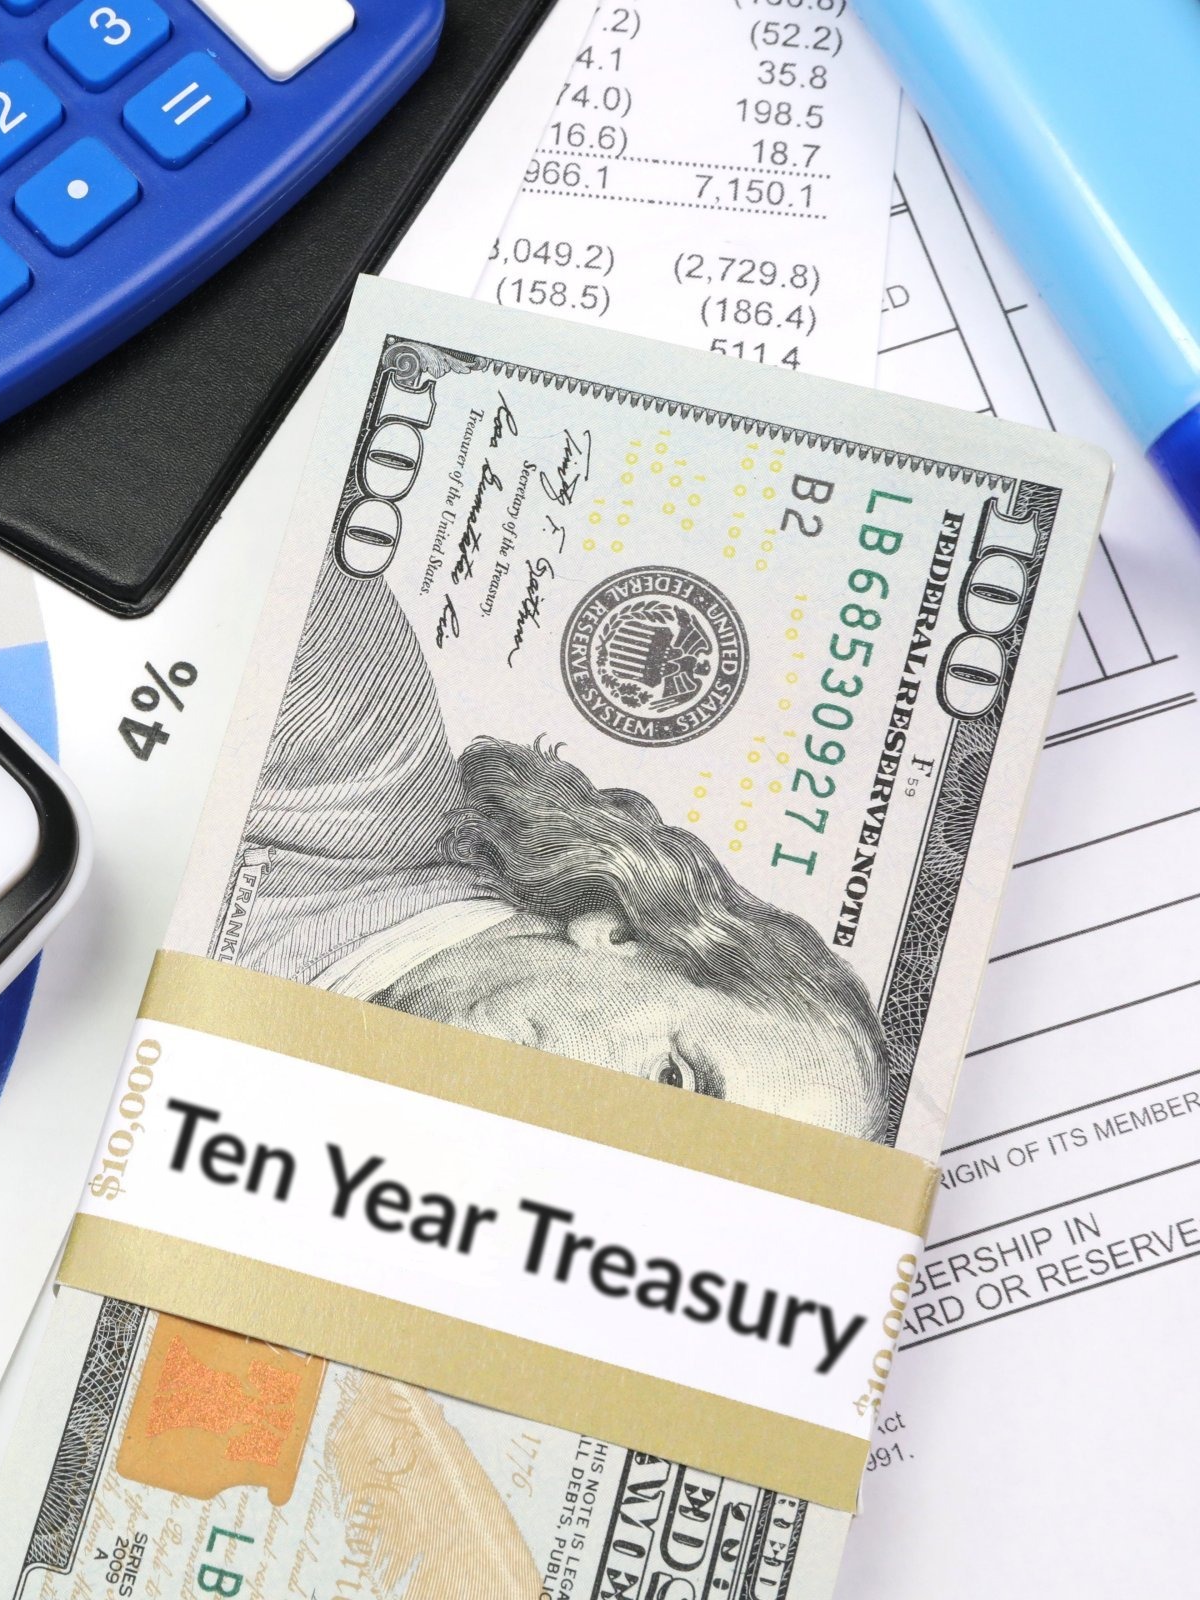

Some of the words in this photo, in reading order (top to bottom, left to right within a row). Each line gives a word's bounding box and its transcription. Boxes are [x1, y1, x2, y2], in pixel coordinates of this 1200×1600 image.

[90, 7, 131, 45] 3
[594, 7, 641, 39] .2)
[750, 20, 843, 57] (52.2)
[757, 60, 827, 89] 35.8
[737, 98, 824, 129] 198.5
[753, 139, 821, 168] 18.7
[694, 174, 815, 209] 7,150.1
[674, 253, 820, 296] (2,729.8)
[881, 285, 910, 312] D
[496, 277, 611, 317] (158.5)
[701, 296, 817, 338] (186.4)
[460, 407, 485, 466] Treasurer
[333, 367, 437, 580] 100
[444, 484, 461, 506] the
[448, 465, 464, 483] of
[505, 459, 538, 519] Secretary
[431, 506, 457, 556] United
[498, 537, 516, 557] the
[501, 518, 517, 538] of
[419, 555, 444, 598] States.
[480, 560, 511, 618] Treasury.
[605, 575, 696, 602] FEDERAL
[903, 508, 966, 675] FEDERAL
[936, 497, 1041, 721] 100
[568, 599, 610, 683] RESERVE
[705, 602, 740, 676] UNITED
[117, 660, 199, 762] 4%
[580, 686, 655, 737] SYSTEM
[675, 676, 732, 732] STATES
[858, 675, 922, 847] RESERVE
[218, 872, 257, 963] FRANKL
[832, 846, 877, 948] NOTE
[88, 1038, 162, 1201] $10,000
[1006, 1140, 1041, 1167] OF
[1047, 1127, 1089, 1156] ITS
[162, 1096, 298, 1206] Ten
[323, 1139, 499, 1256] Year
[515, 1196, 870, 1377] Treasury
[1064, 1212, 1102, 1246] IN
[975, 1273, 1032, 1311] OR
[877, 1411, 907, 1434] ct
[573, 1435, 593, 1462] LL
[556, 1466, 586, 1530] DEBTS,
[577, 1478, 600, 1530] NOTE
[93, 1547, 109, 1560] A
[105, 1535, 130, 1585] 2009
[119, 1531, 148, 1598] SERIES
[197, 1525, 255, 1598] LB
[569, 1531, 586, 1549] IS
